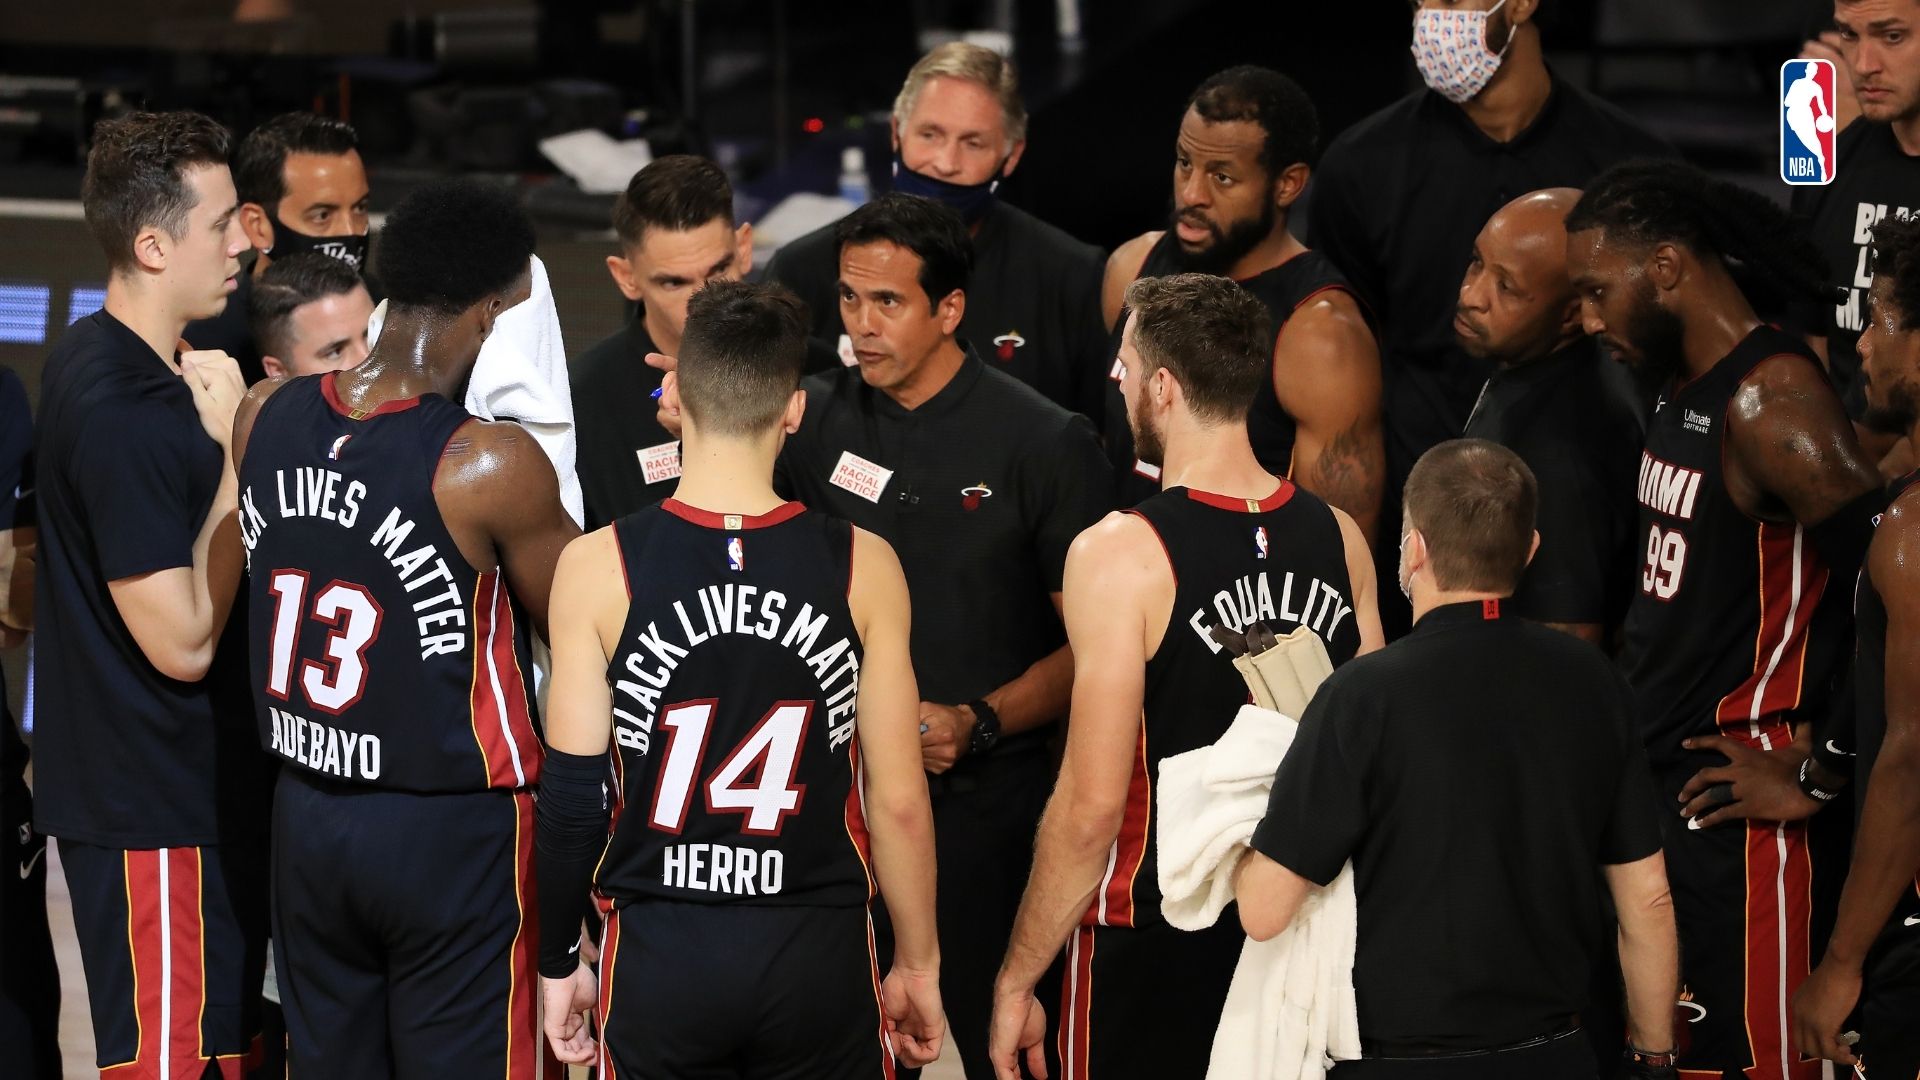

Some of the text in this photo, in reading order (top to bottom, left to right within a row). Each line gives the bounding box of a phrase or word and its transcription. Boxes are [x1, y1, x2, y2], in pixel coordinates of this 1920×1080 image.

[646, 455, 680, 470] RACIA
[648, 466, 683, 481] JUSTIC
[833, 474, 878, 499] JUSTICE
[839, 465, 880, 489] RACIAL
[276, 466, 367, 528] LIVES
[370, 506, 466, 661] MATTER
[1642, 523, 1688, 600] 99
[266, 568, 384, 716] 13
[1189, 571, 1352, 655] EQUALITY
[613, 583, 859, 757] BLACK LIVES MATTER
[268, 706, 381, 780] ADEBAYO
[648, 698, 816, 836] 14
[663, 844, 784, 896] HERRO
